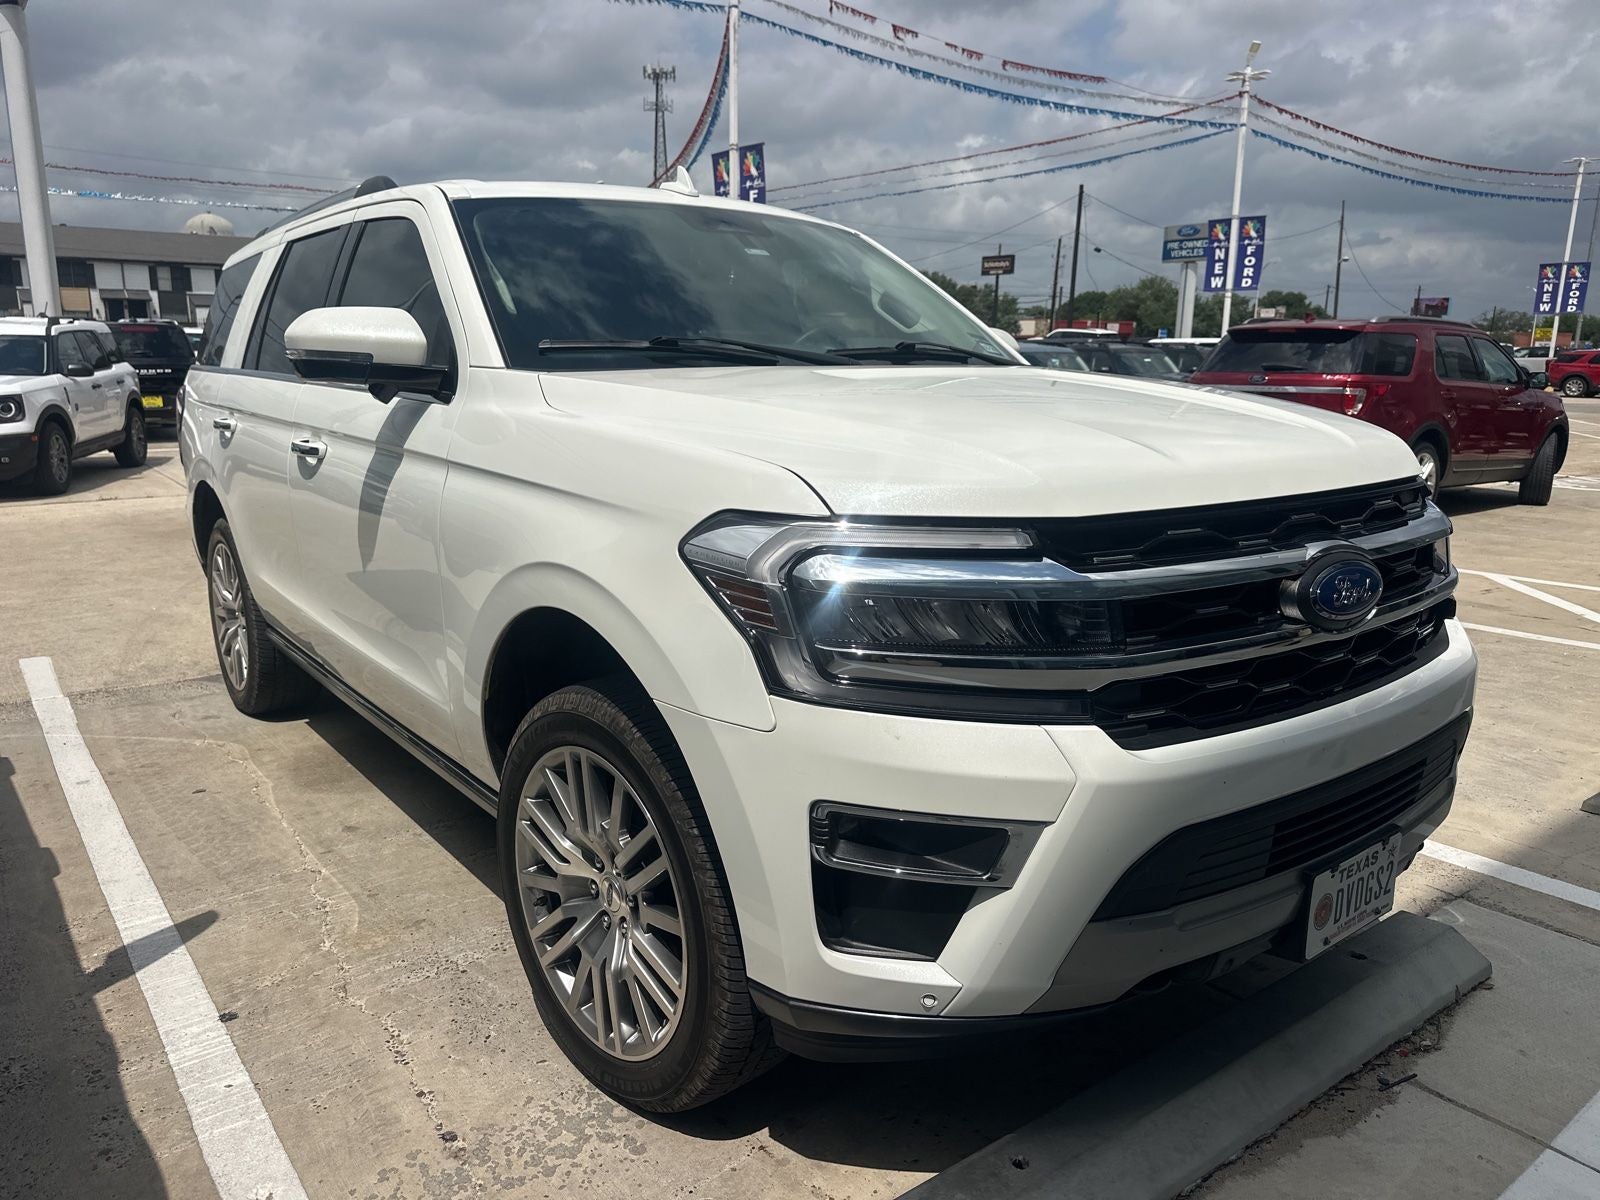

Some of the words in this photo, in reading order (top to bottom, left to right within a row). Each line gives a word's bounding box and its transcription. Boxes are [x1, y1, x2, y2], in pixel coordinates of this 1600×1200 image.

[1171, 249, 1204, 257] VEHICLES
[1210, 248, 1225, 288] NEW
[1241, 246, 1256, 287] FORD
[1540, 283, 1553, 312] NEW
[1567, 283, 1580, 312] FORD
[1338, 850, 1379, 883] TEXAS
